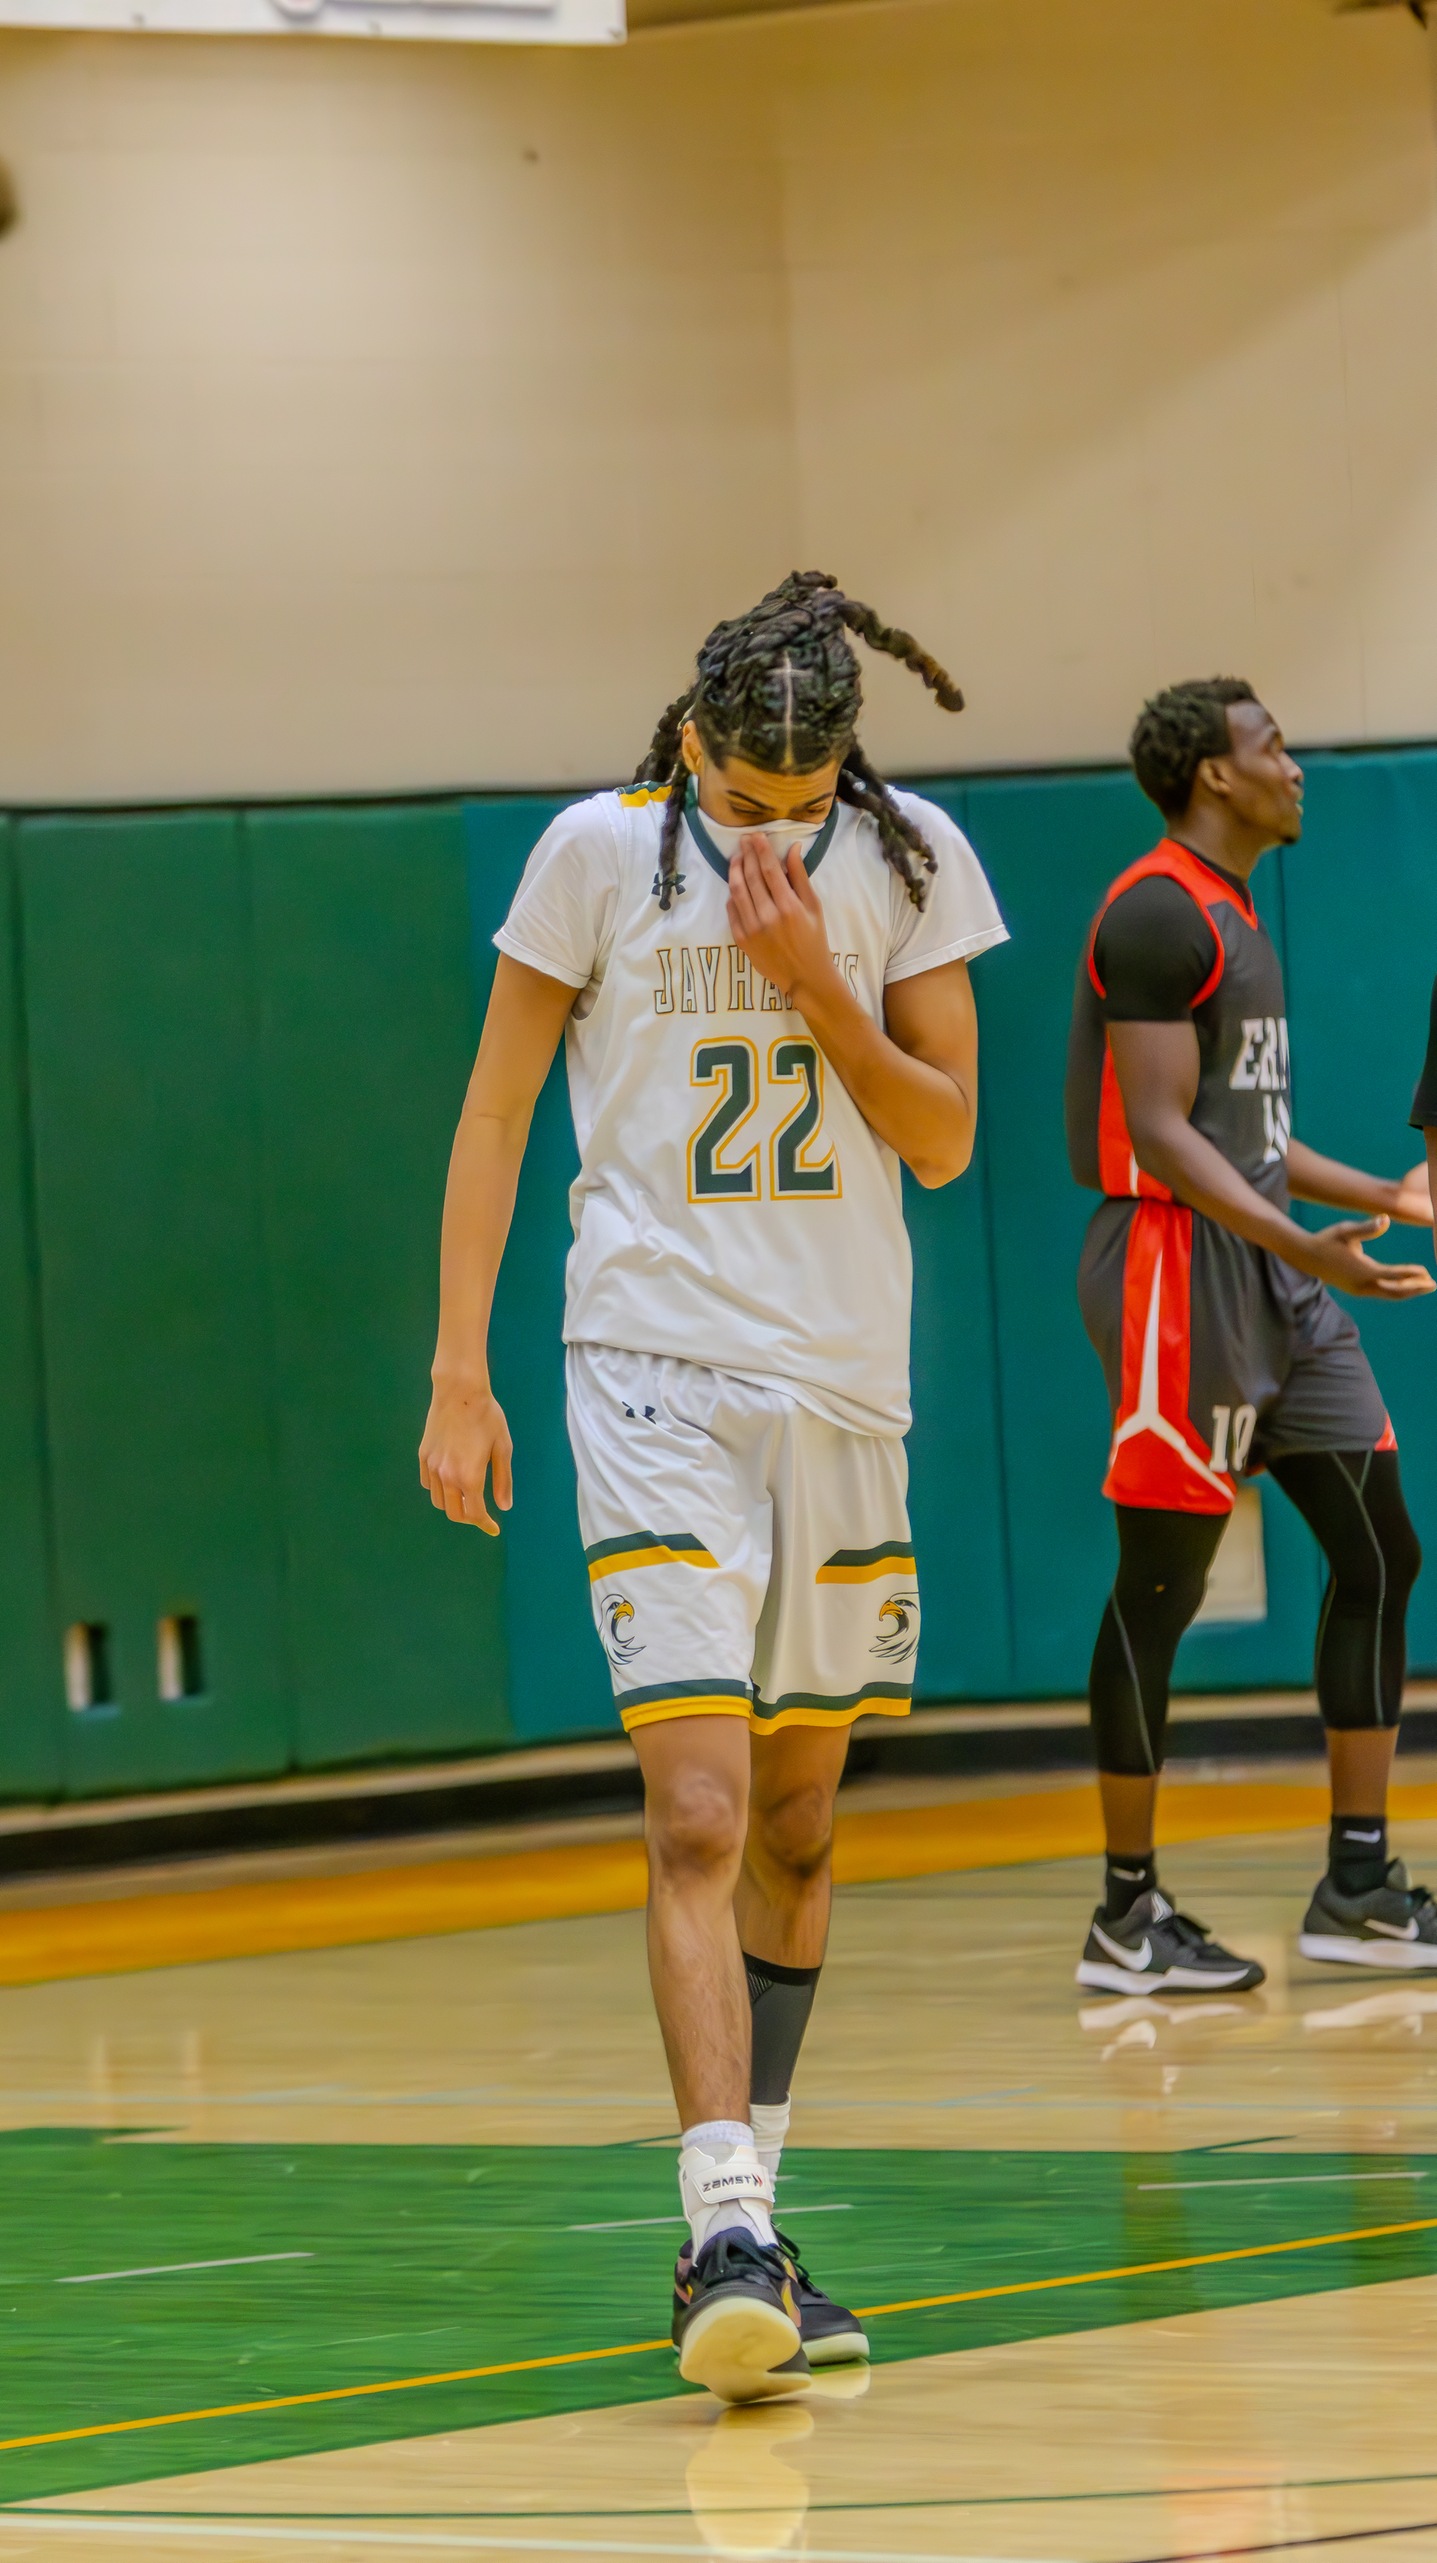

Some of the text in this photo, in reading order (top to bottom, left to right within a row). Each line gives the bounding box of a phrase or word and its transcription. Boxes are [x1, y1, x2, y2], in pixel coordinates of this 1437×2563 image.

[654, 945, 860, 1014] JAYHAS
[687, 1035, 843, 1204] 22
[1209, 1404, 1257, 1473] 10
